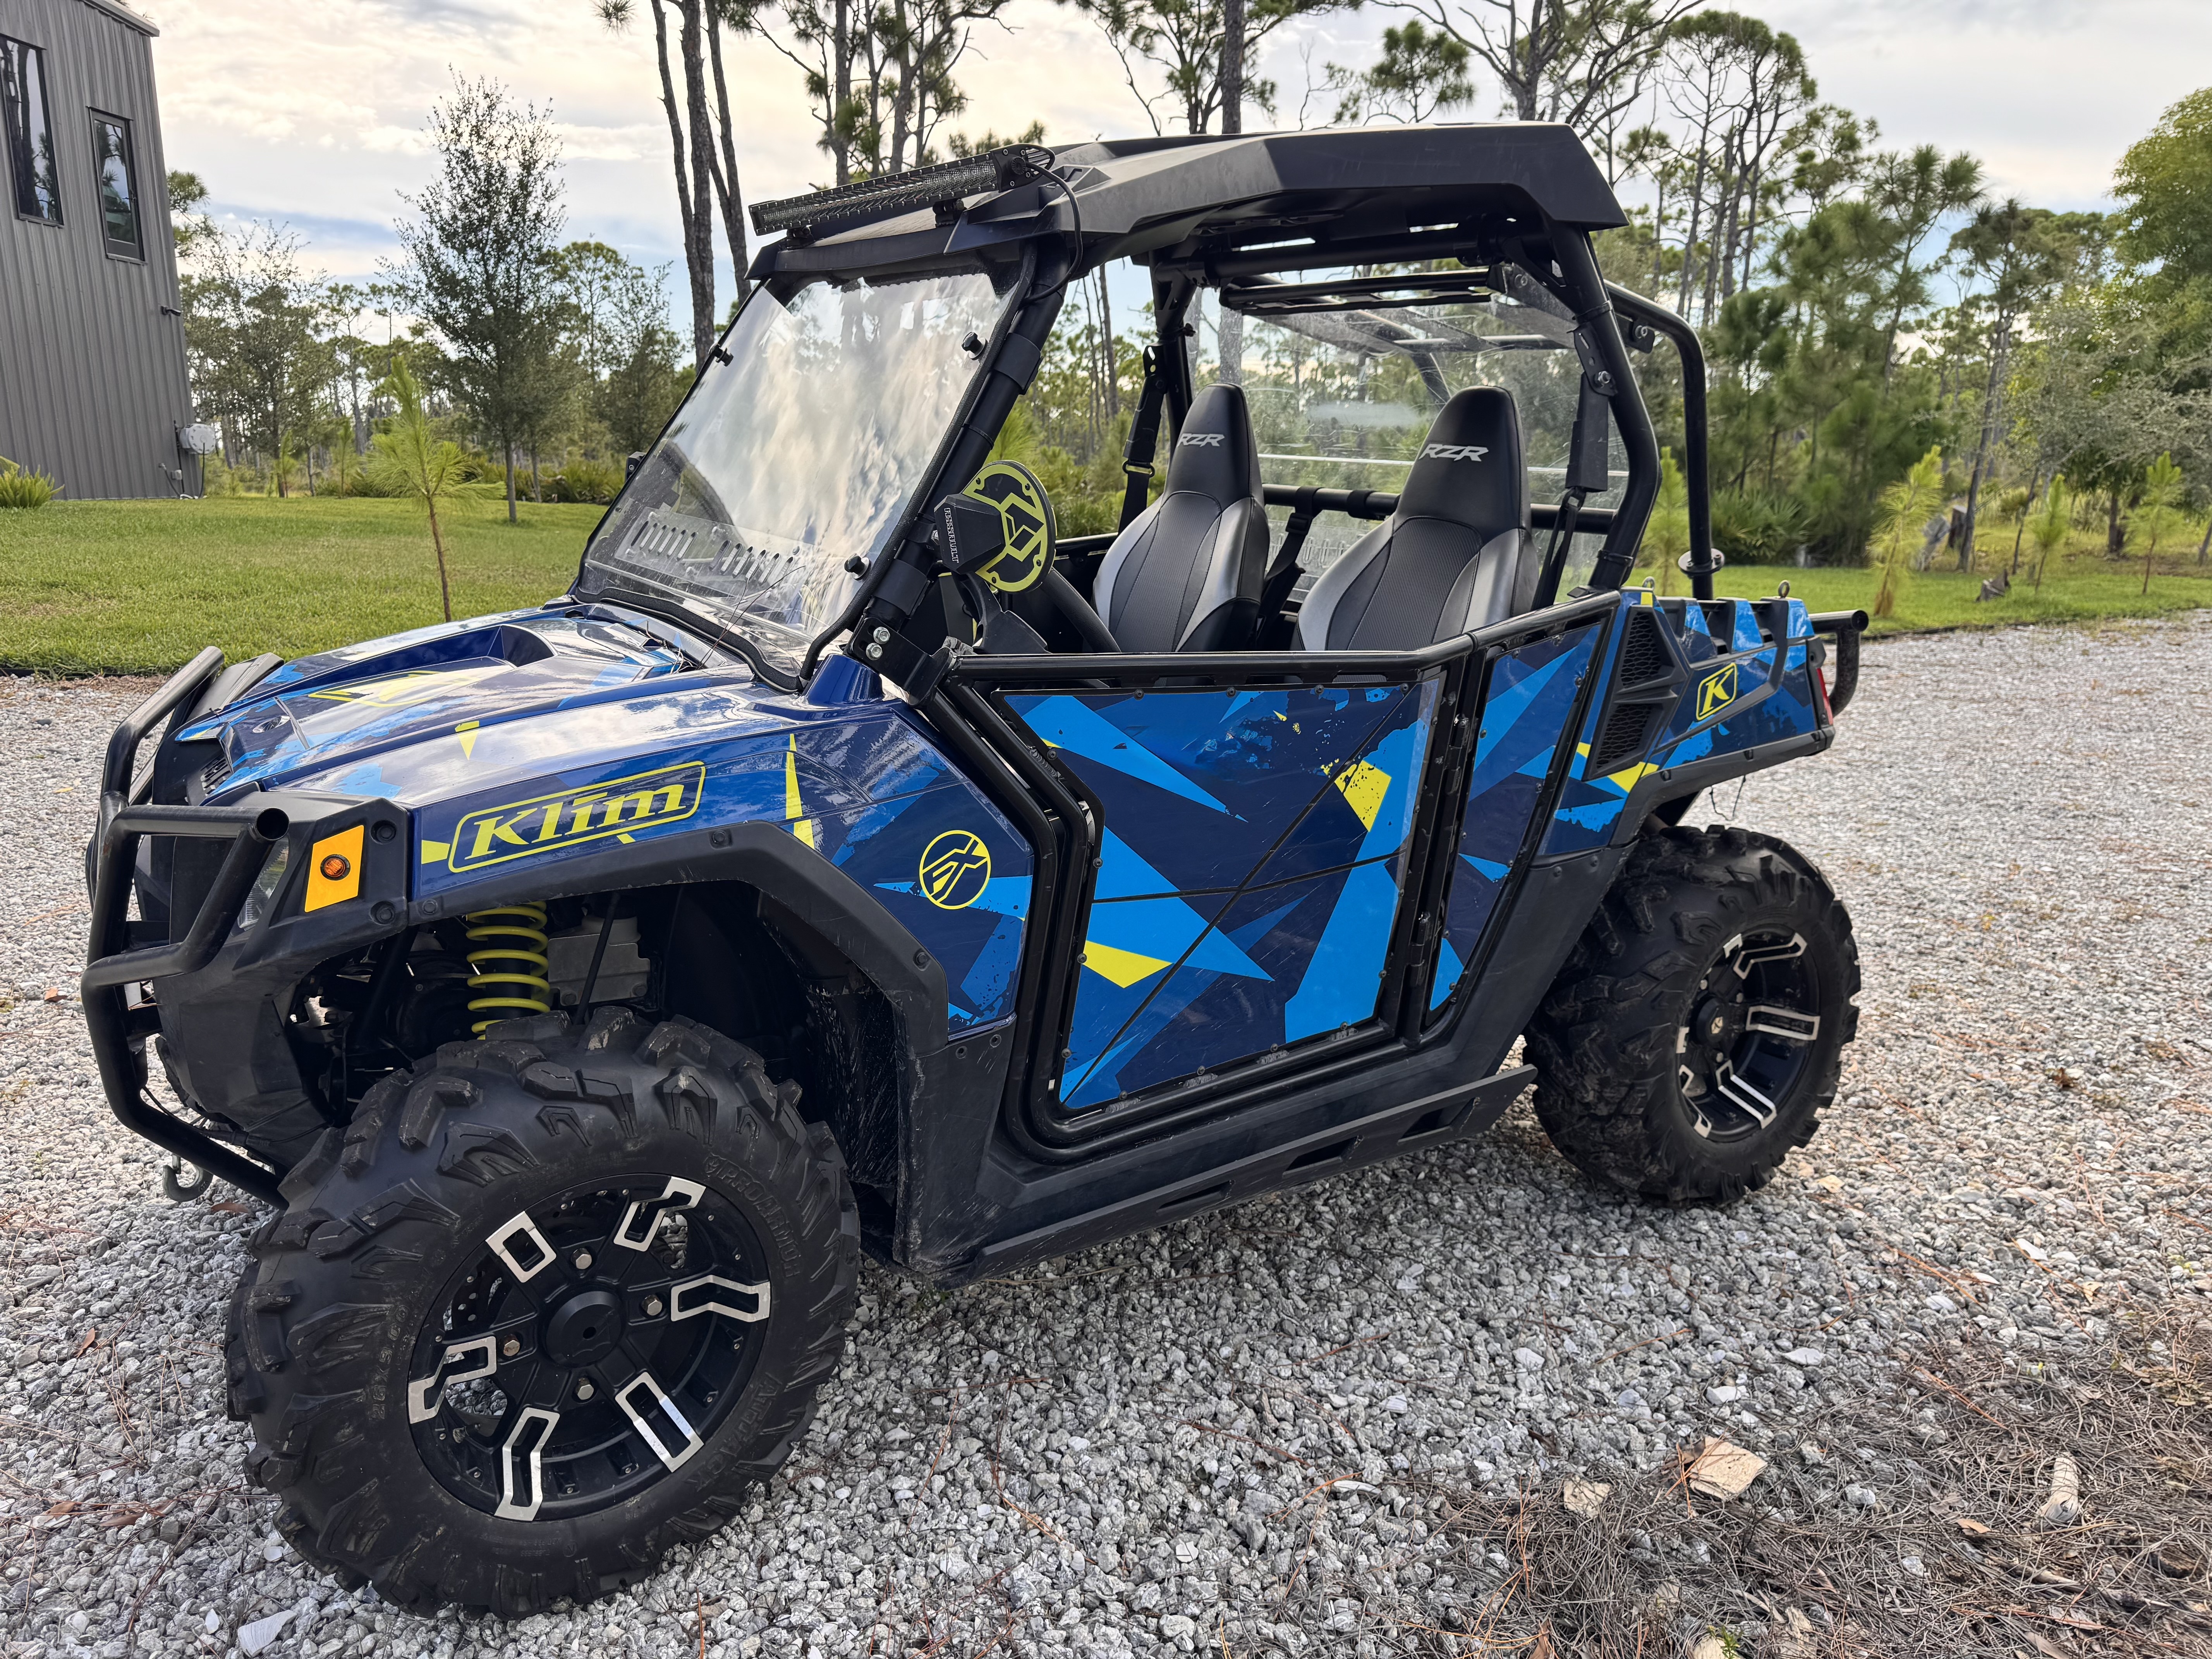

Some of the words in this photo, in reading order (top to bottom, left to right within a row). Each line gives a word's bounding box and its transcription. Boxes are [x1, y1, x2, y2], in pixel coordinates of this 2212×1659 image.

[1177, 433, 1224, 447] RZR
[1419, 444, 1489, 462] RZR
[944, 508, 959, 563] ASSAULT
[1700, 668, 1734, 716] K
